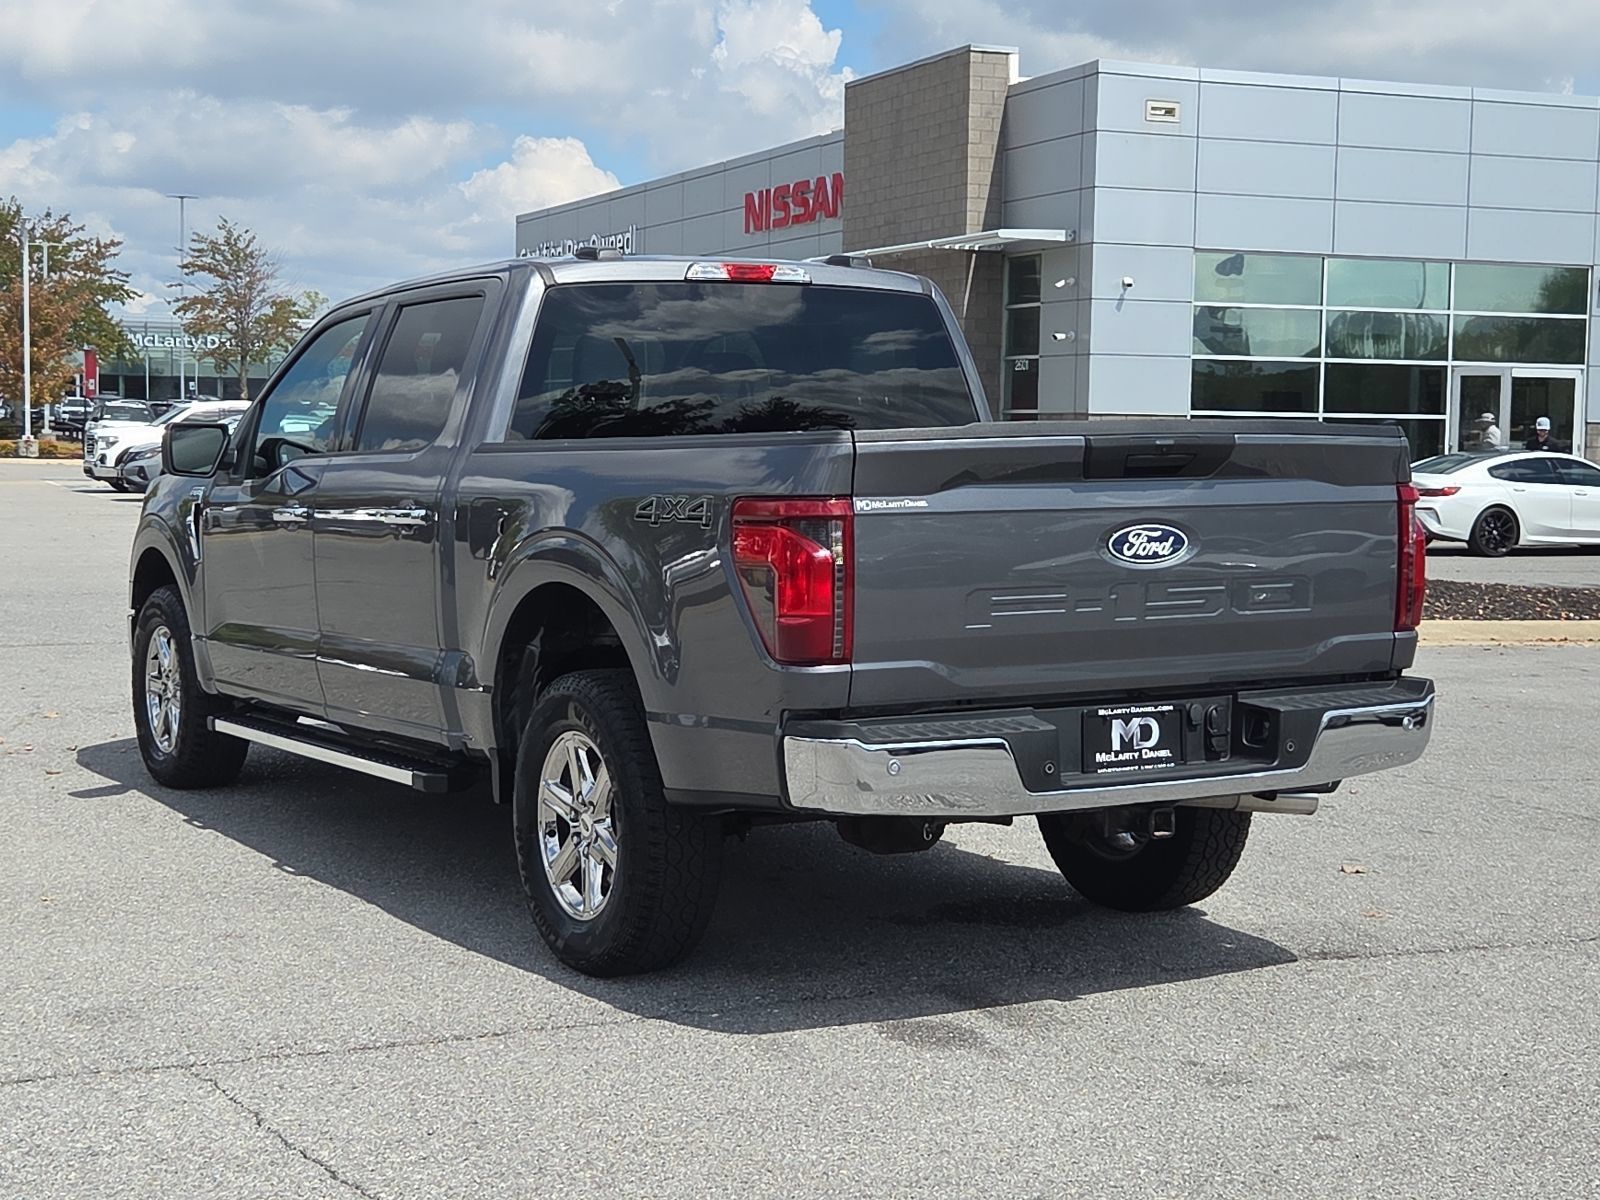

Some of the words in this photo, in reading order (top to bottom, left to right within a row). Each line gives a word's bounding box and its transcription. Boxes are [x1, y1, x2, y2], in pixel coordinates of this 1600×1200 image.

[127, 333, 201, 352] McLarty
[1123, 529, 1175, 556] Ford
[964, 576, 1315, 629] F-150
[1111, 717, 1160, 751] MD
